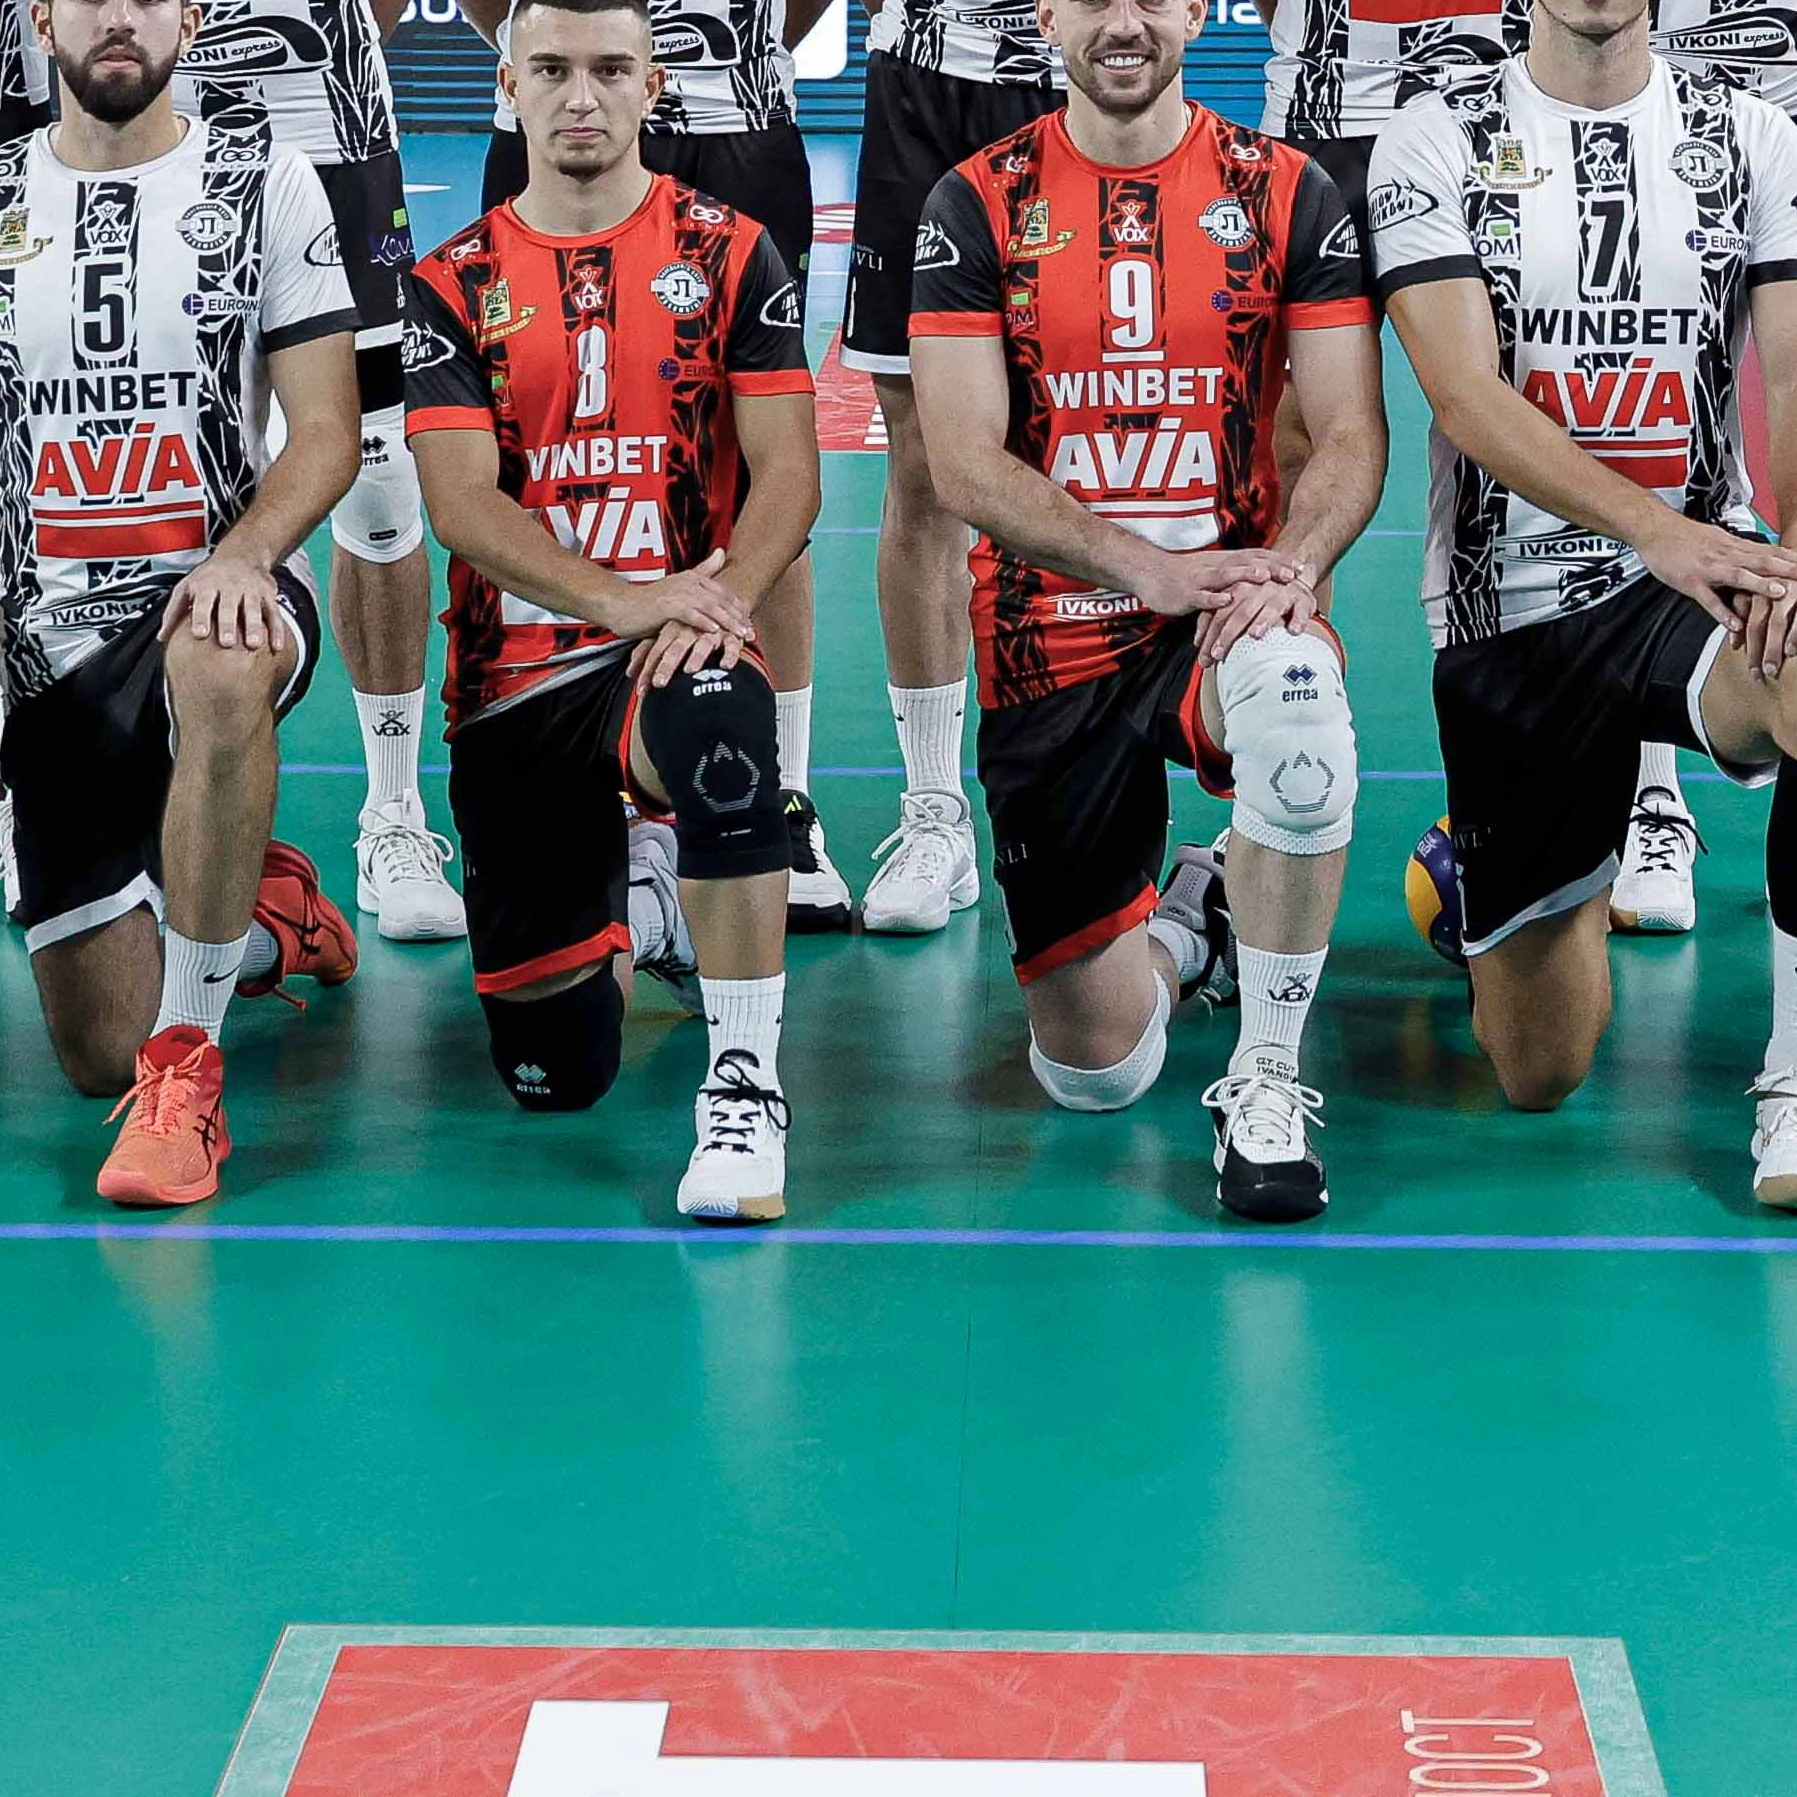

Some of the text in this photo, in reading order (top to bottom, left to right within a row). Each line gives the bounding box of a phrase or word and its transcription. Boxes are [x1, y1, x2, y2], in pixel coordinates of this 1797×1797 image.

[230, 38, 283, 60] express
[658, 32, 701, 52] express
[1668, 28, 1788, 50] IVKONI express
[1590, 199, 1625, 290] 7
[852, 251, 883, 271] VLI
[82, 260, 128, 352] 5
[1109, 261, 1154, 348] 9
[1520, 308, 1697, 345] WINBET
[28, 372, 195, 416] WINBET
[1046, 367, 1223, 408] WINBET
[1518, 538, 1603, 556] IVKONI
[1057, 597, 1139, 615] IVKONI
[692, 679, 732, 696] errea
[1281, 687, 1319, 702] errea
